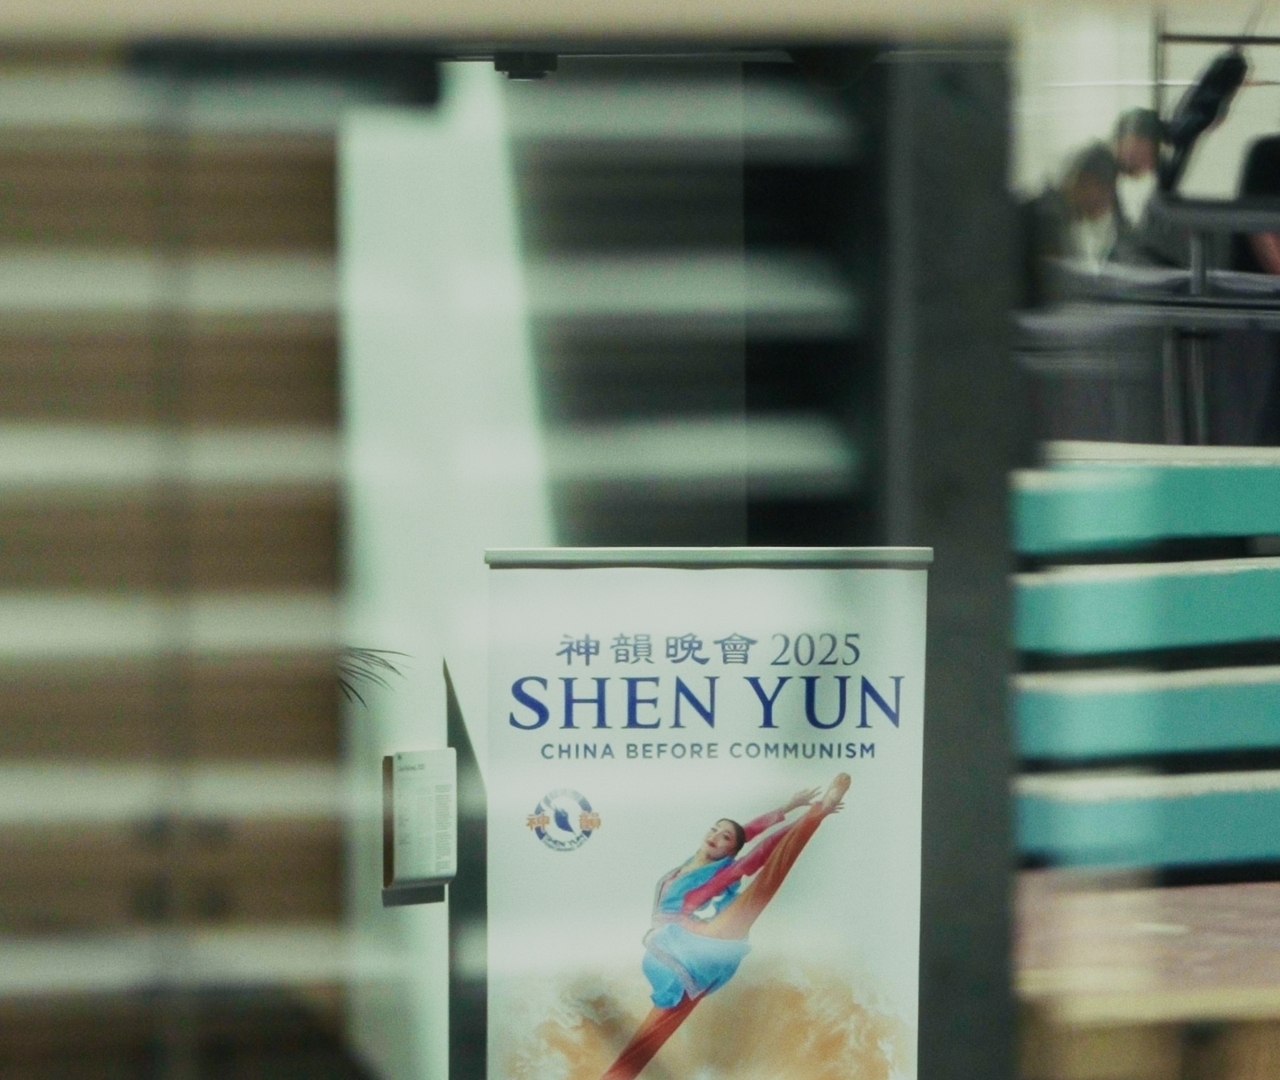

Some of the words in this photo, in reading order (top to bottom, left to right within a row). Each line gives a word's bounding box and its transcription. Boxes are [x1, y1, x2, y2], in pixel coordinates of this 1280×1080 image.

[556, 633, 759, 666] 神韻晚會
[770, 633, 861, 666] 2025
[508, 676, 720, 731] SHEN
[743, 675, 905, 730] YUN
[541, 743, 615, 760] CHINA
[627, 743, 719, 760] BEFORE
[730, 742, 876, 759] COMMUNISM
